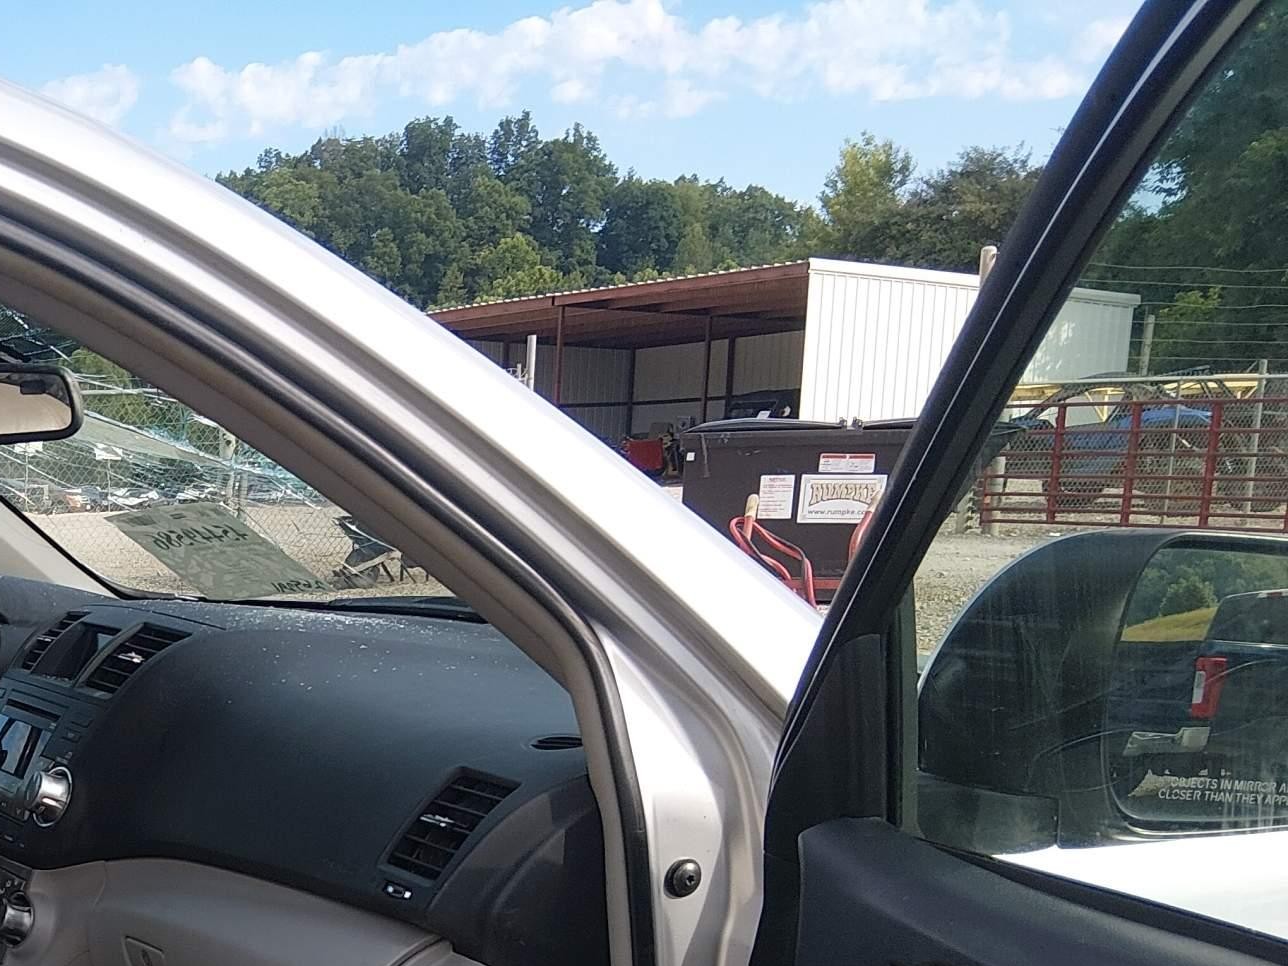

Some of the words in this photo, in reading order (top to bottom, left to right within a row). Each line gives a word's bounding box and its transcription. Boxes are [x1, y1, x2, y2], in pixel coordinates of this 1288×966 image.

[1171, 776, 1218, 789] OBJECTS
[1219, 779, 1233, 790] IN
[1233, 779, 1277, 792] MIRROR
[1158, 788, 1202, 801] CLOSER
[1204, 791, 1233, 802] THAN
[1235, 792, 1265, 804] THEY
[1264, 794, 1288, 806] APP
